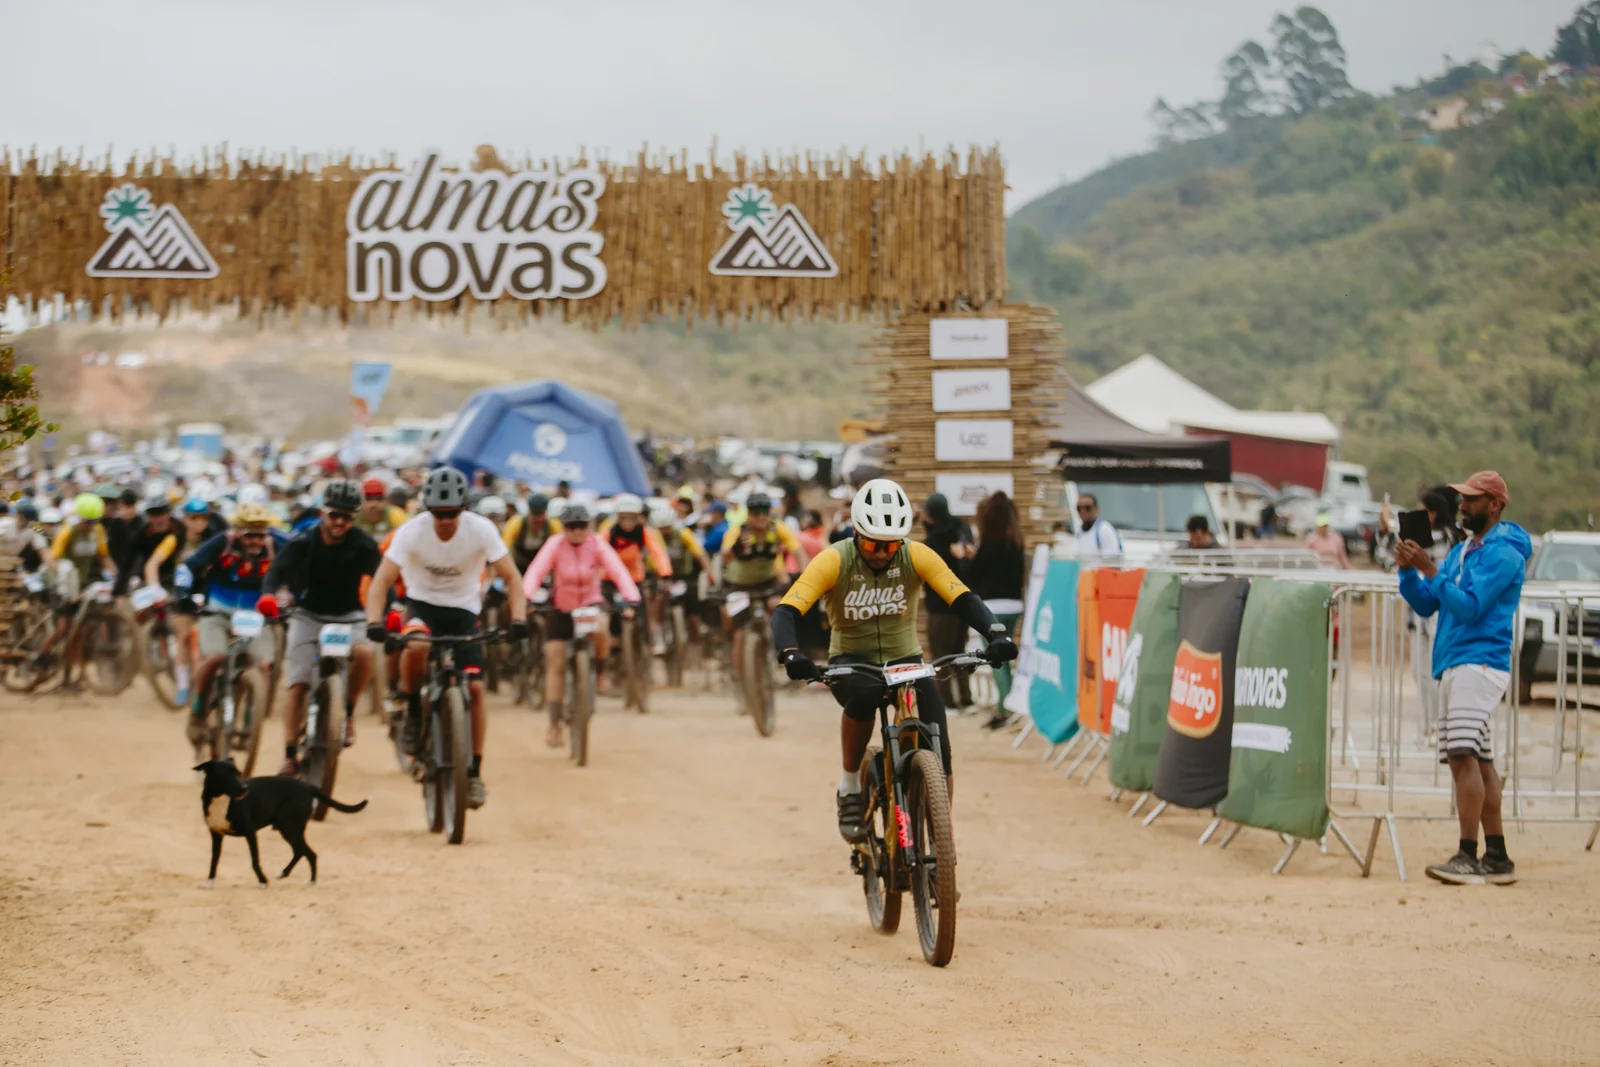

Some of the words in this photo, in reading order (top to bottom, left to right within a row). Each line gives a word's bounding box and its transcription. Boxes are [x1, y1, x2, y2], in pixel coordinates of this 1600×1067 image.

[355, 153, 596, 233] almas
[355, 241, 596, 294] novas
[843, 583, 906, 607] almas
[843, 600, 908, 621] novas
